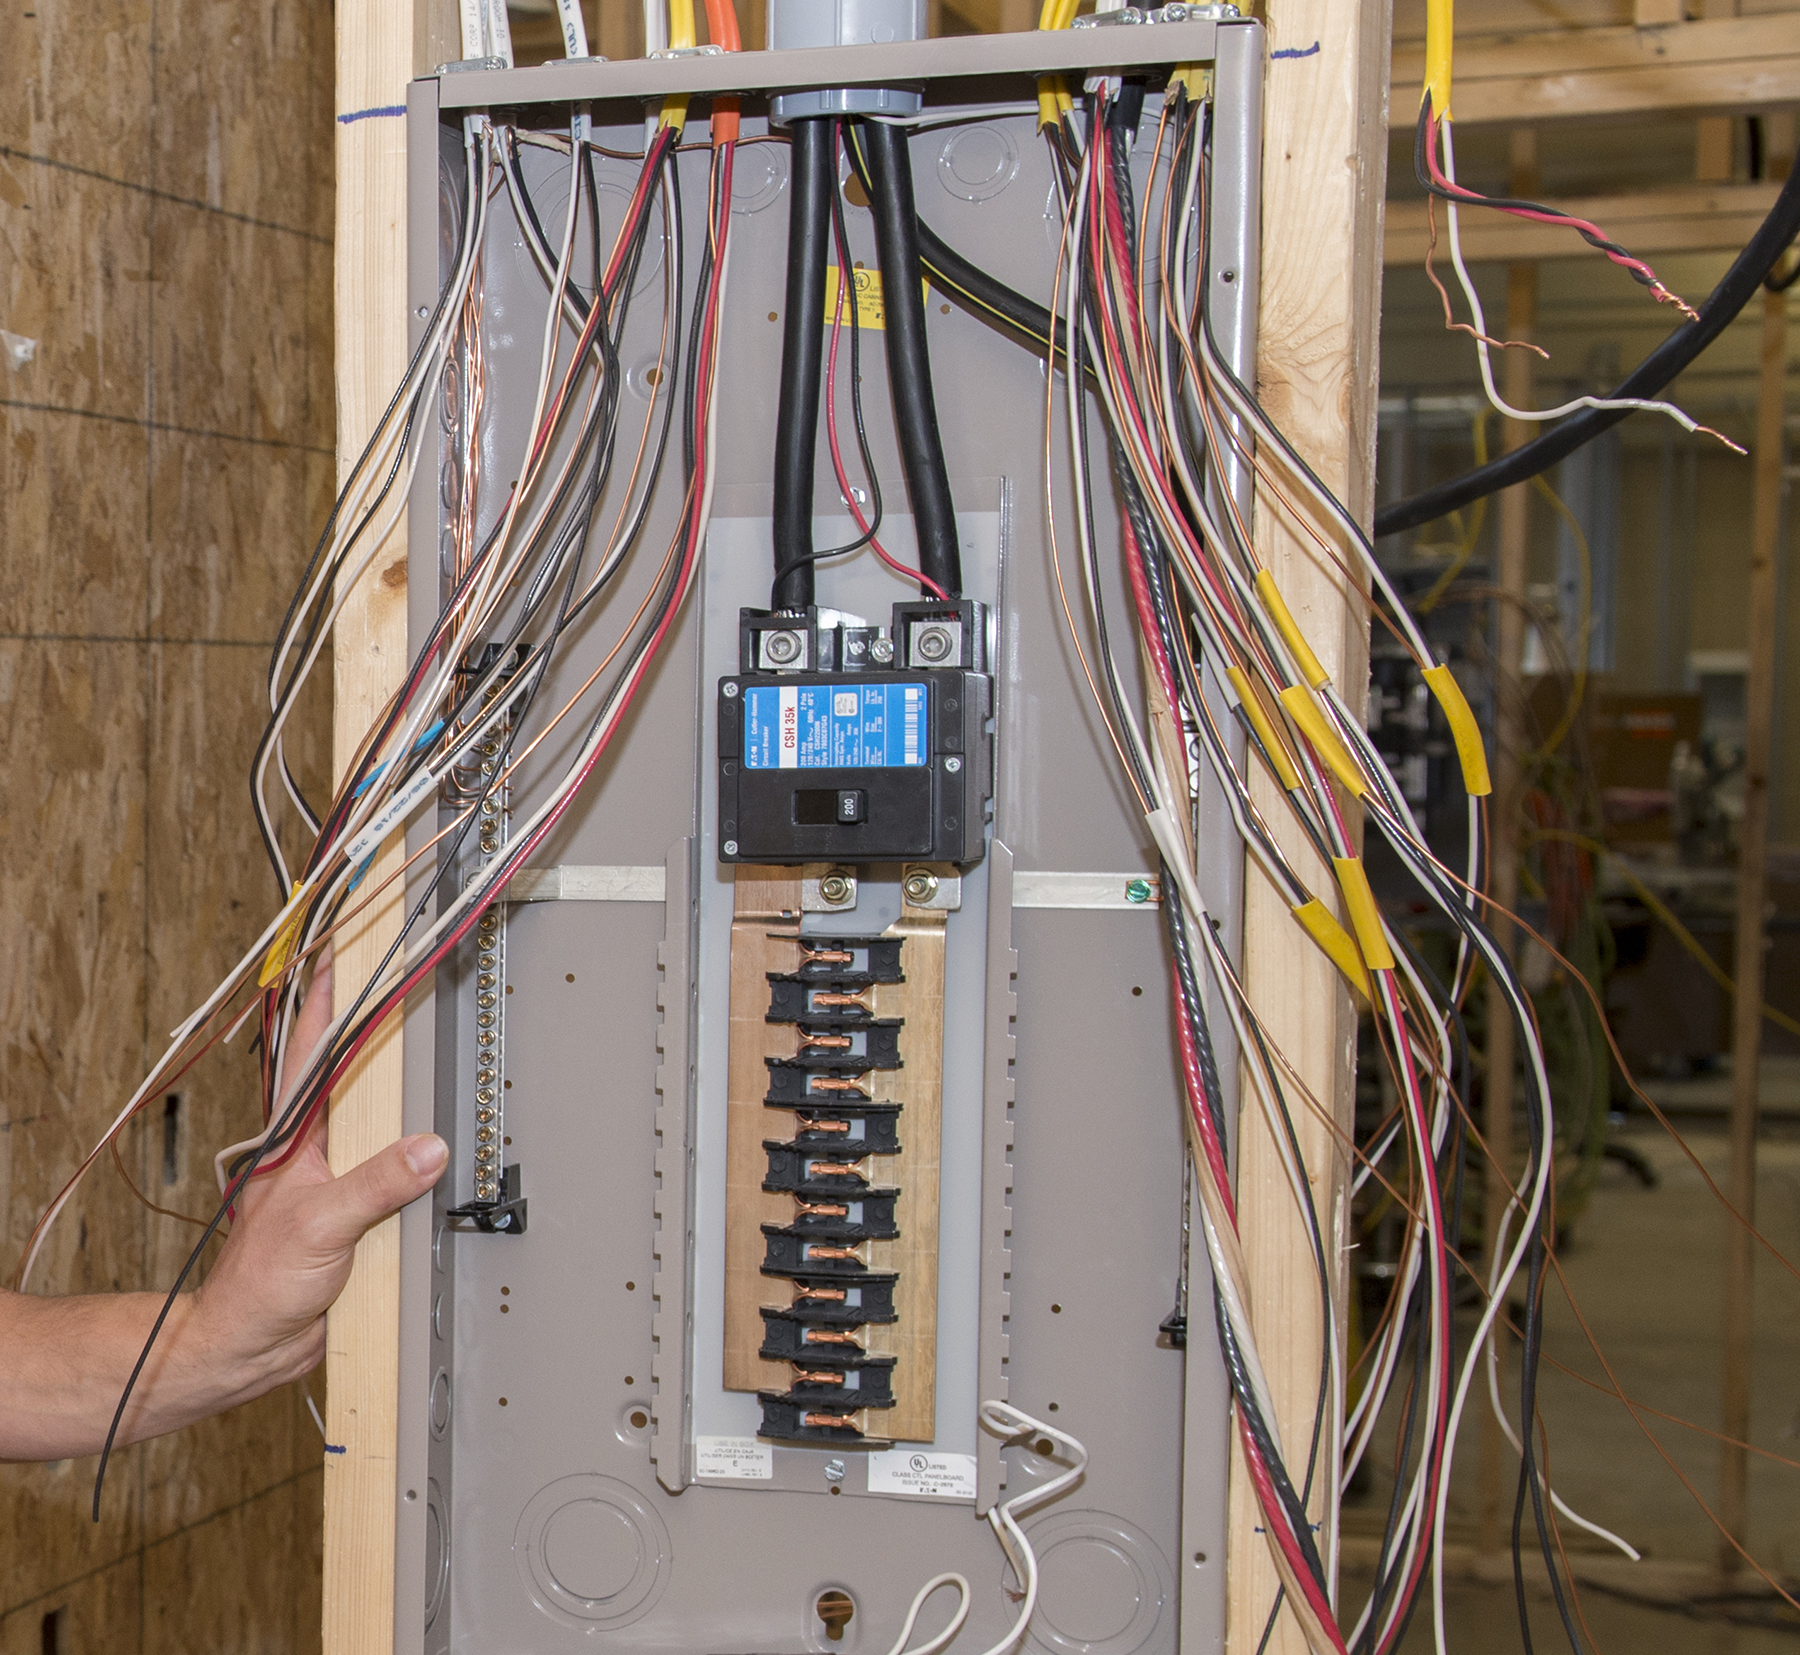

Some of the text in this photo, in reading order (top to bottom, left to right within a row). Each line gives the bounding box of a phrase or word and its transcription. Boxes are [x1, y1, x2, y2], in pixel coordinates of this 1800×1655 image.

[784, 706, 795, 748] CSH 35k
[844, 798, 854, 815] 200
